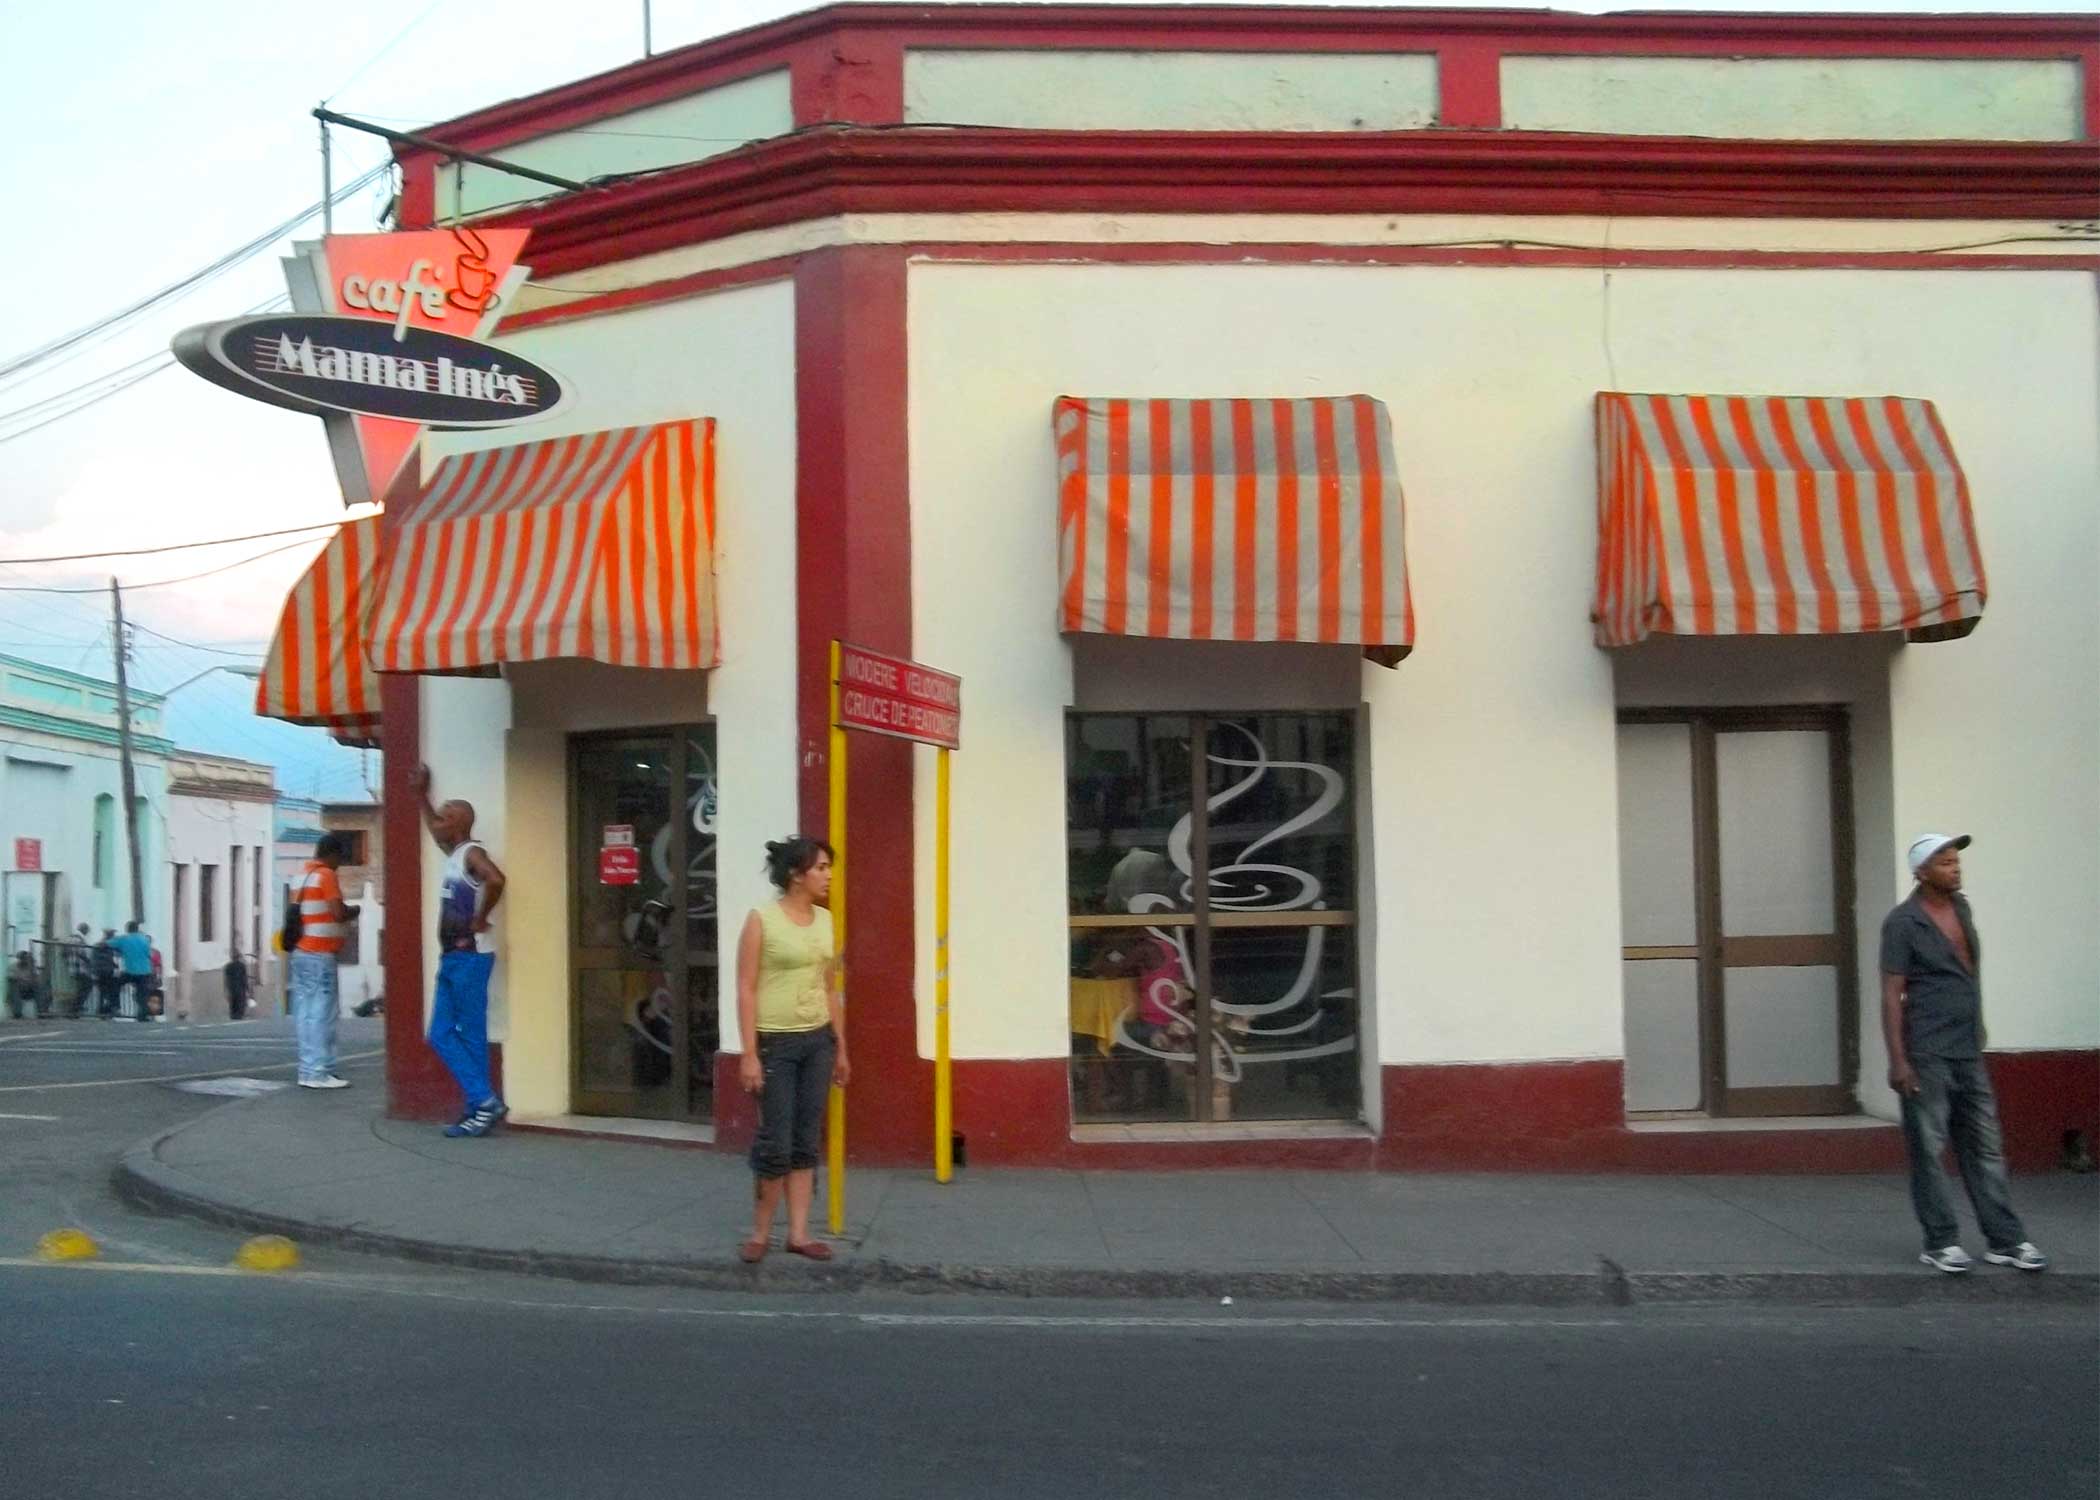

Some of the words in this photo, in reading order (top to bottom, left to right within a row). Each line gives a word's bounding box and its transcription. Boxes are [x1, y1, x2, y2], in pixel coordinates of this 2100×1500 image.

[344, 260, 447, 342] café
[275, 332, 431, 392] Mama
[439, 357, 526, 405] Inés
[846, 654, 896, 690] MODERE
[845, 689, 889, 723] CRUCE
[891, 701, 908, 726] DE
